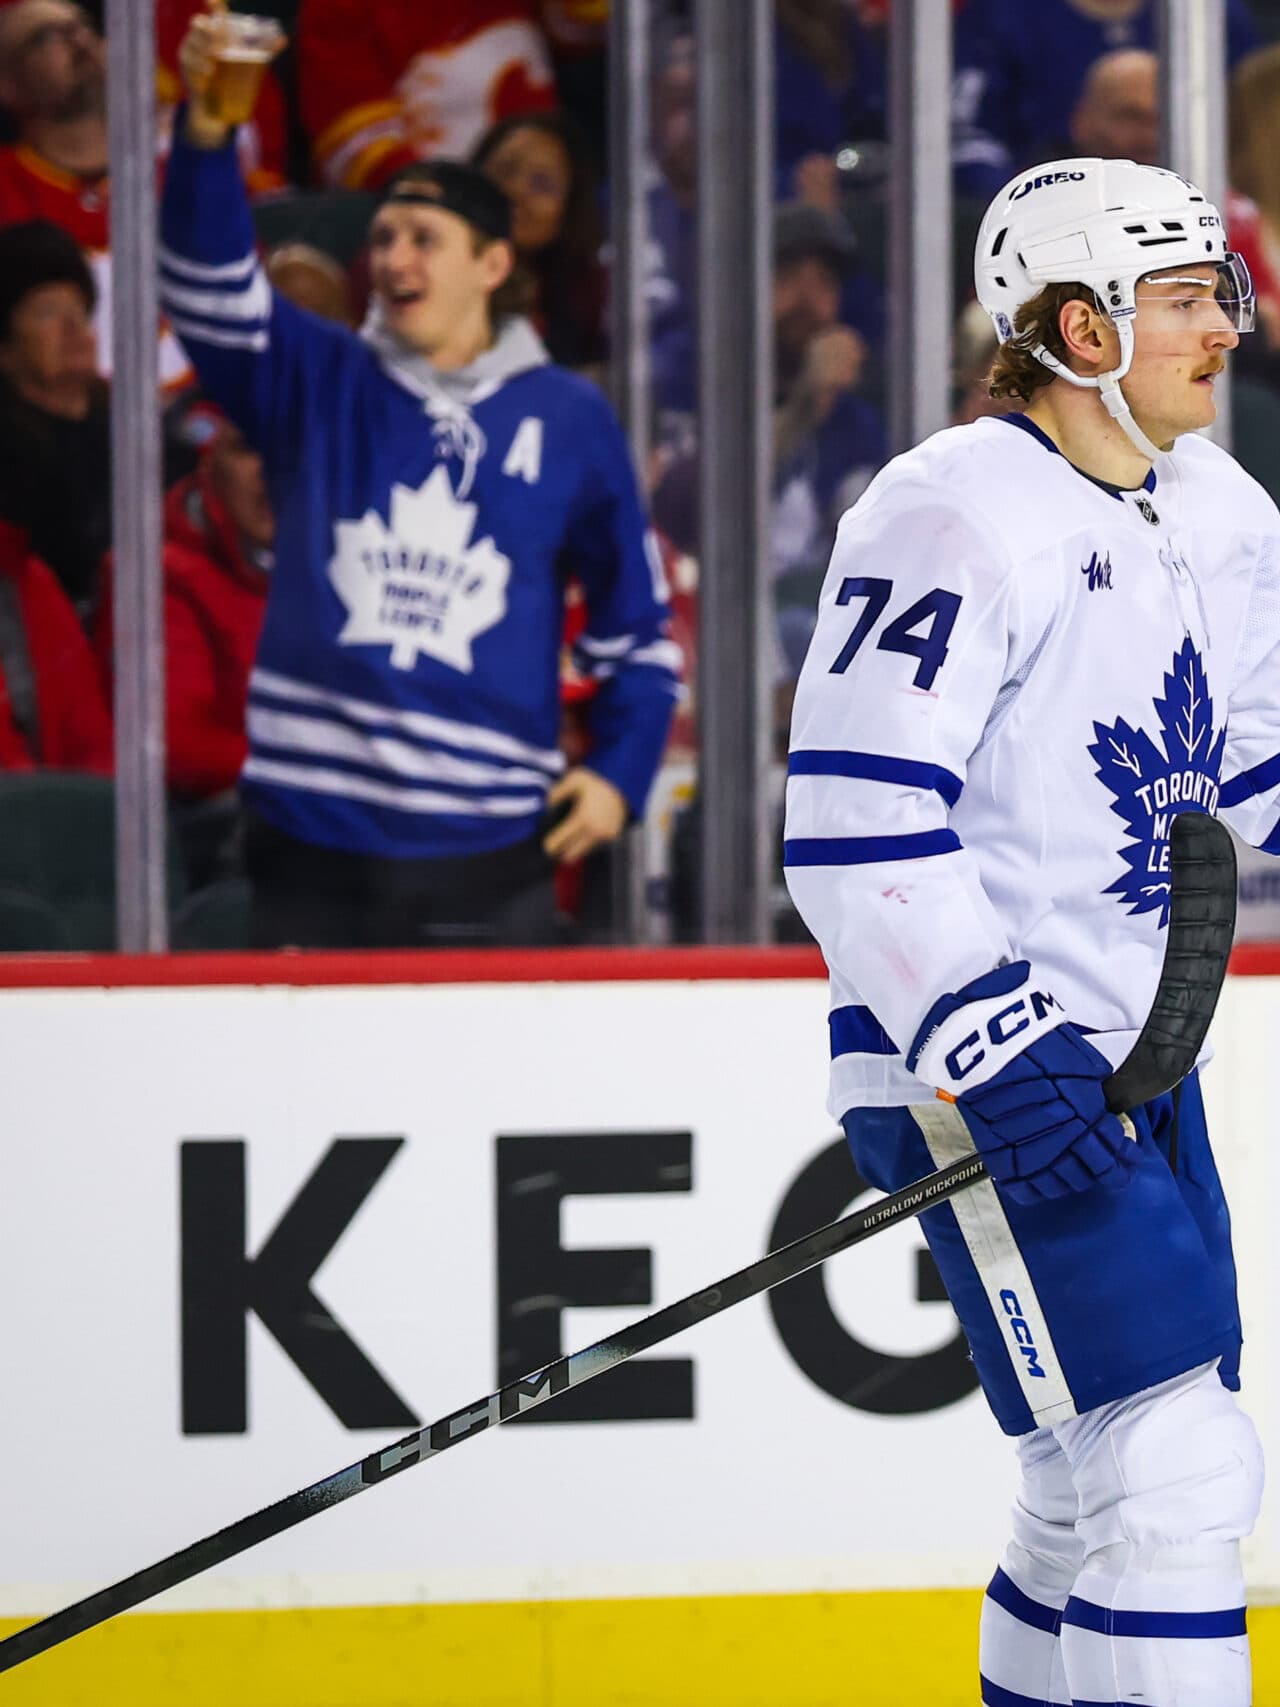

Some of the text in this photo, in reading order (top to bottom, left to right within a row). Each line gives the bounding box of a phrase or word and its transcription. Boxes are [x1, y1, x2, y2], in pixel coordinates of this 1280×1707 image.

[1008, 171, 1086, 201] OREO
[502, 415, 544, 486] A
[827, 576, 963, 692] 74
[1133, 769, 1220, 817] TORONTO
[944, 990, 1065, 1081] CCM
[863, 1160, 984, 1230] ULTRALOW KICKPOINT
[180, 1130, 984, 1438] KEG
[999, 1287, 1047, 1380] CCM
[361, 1356, 571, 1485] CCM
